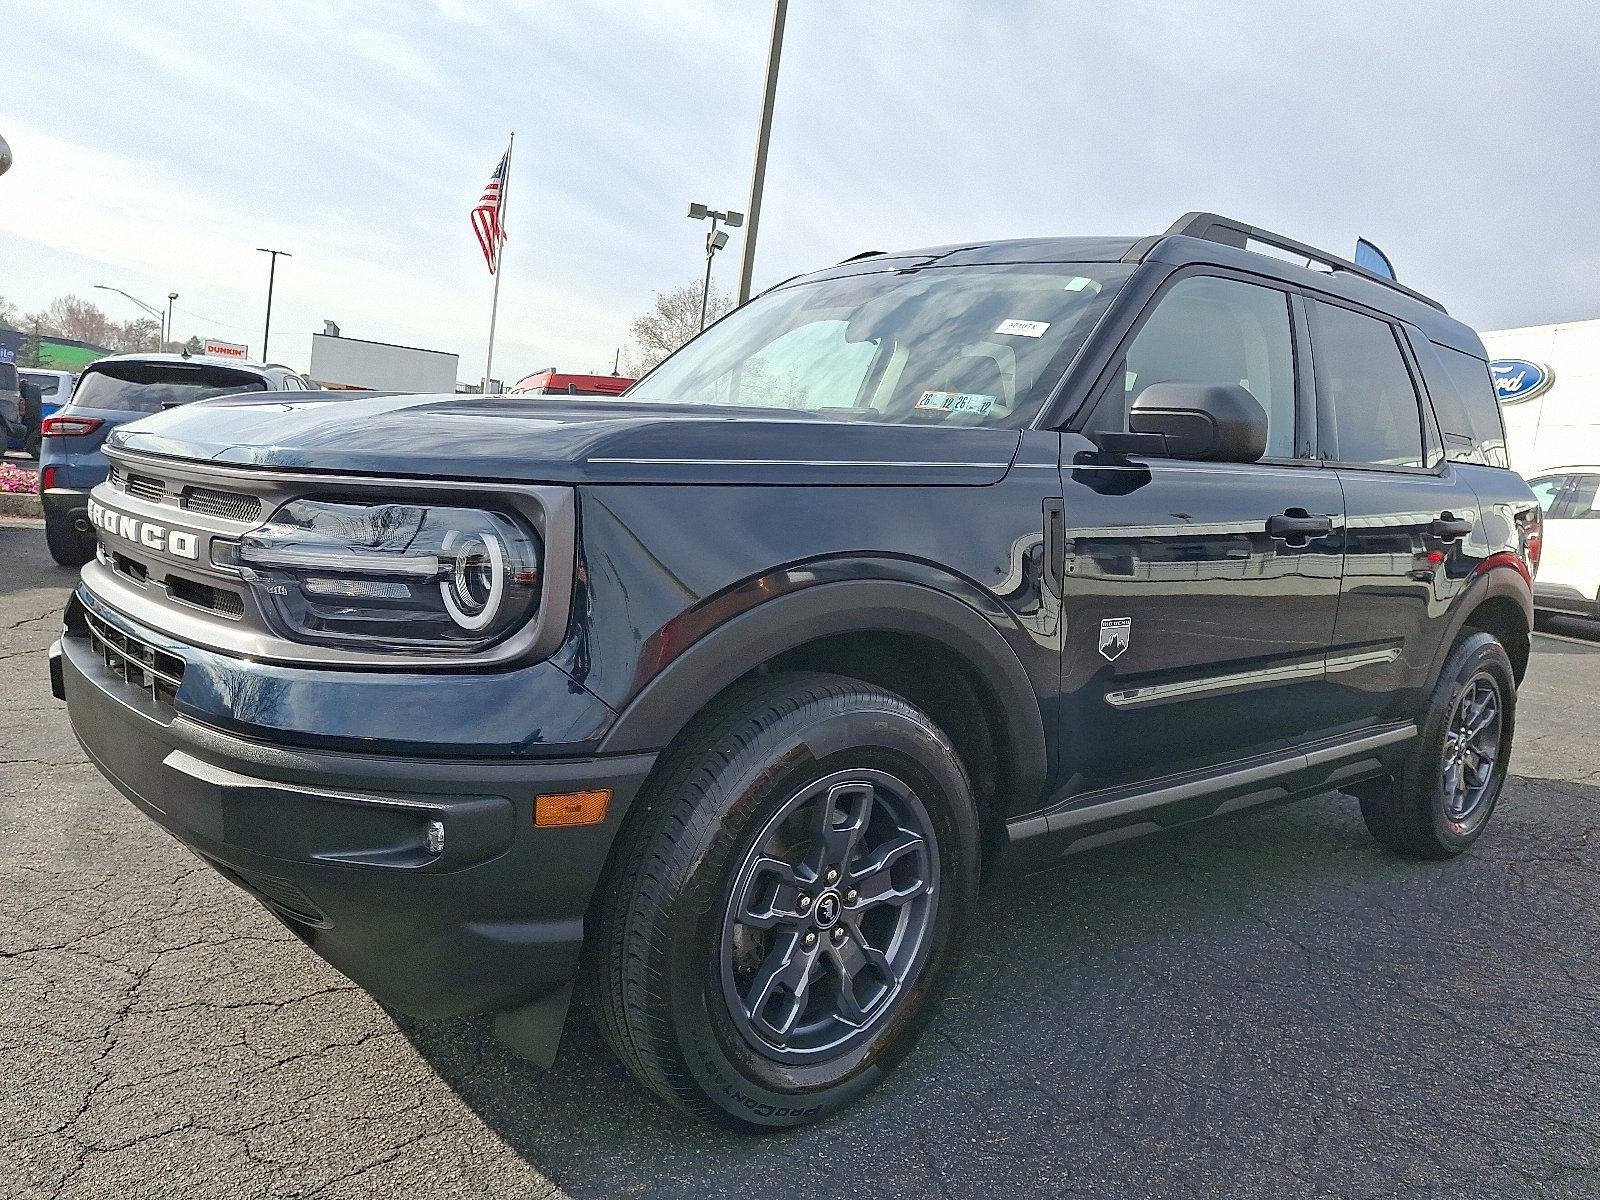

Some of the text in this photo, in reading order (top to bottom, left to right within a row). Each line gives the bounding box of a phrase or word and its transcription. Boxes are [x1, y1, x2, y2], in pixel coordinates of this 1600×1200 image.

[920, 393, 955, 409] 26 12
[955, 395, 991, 412] 26 12
